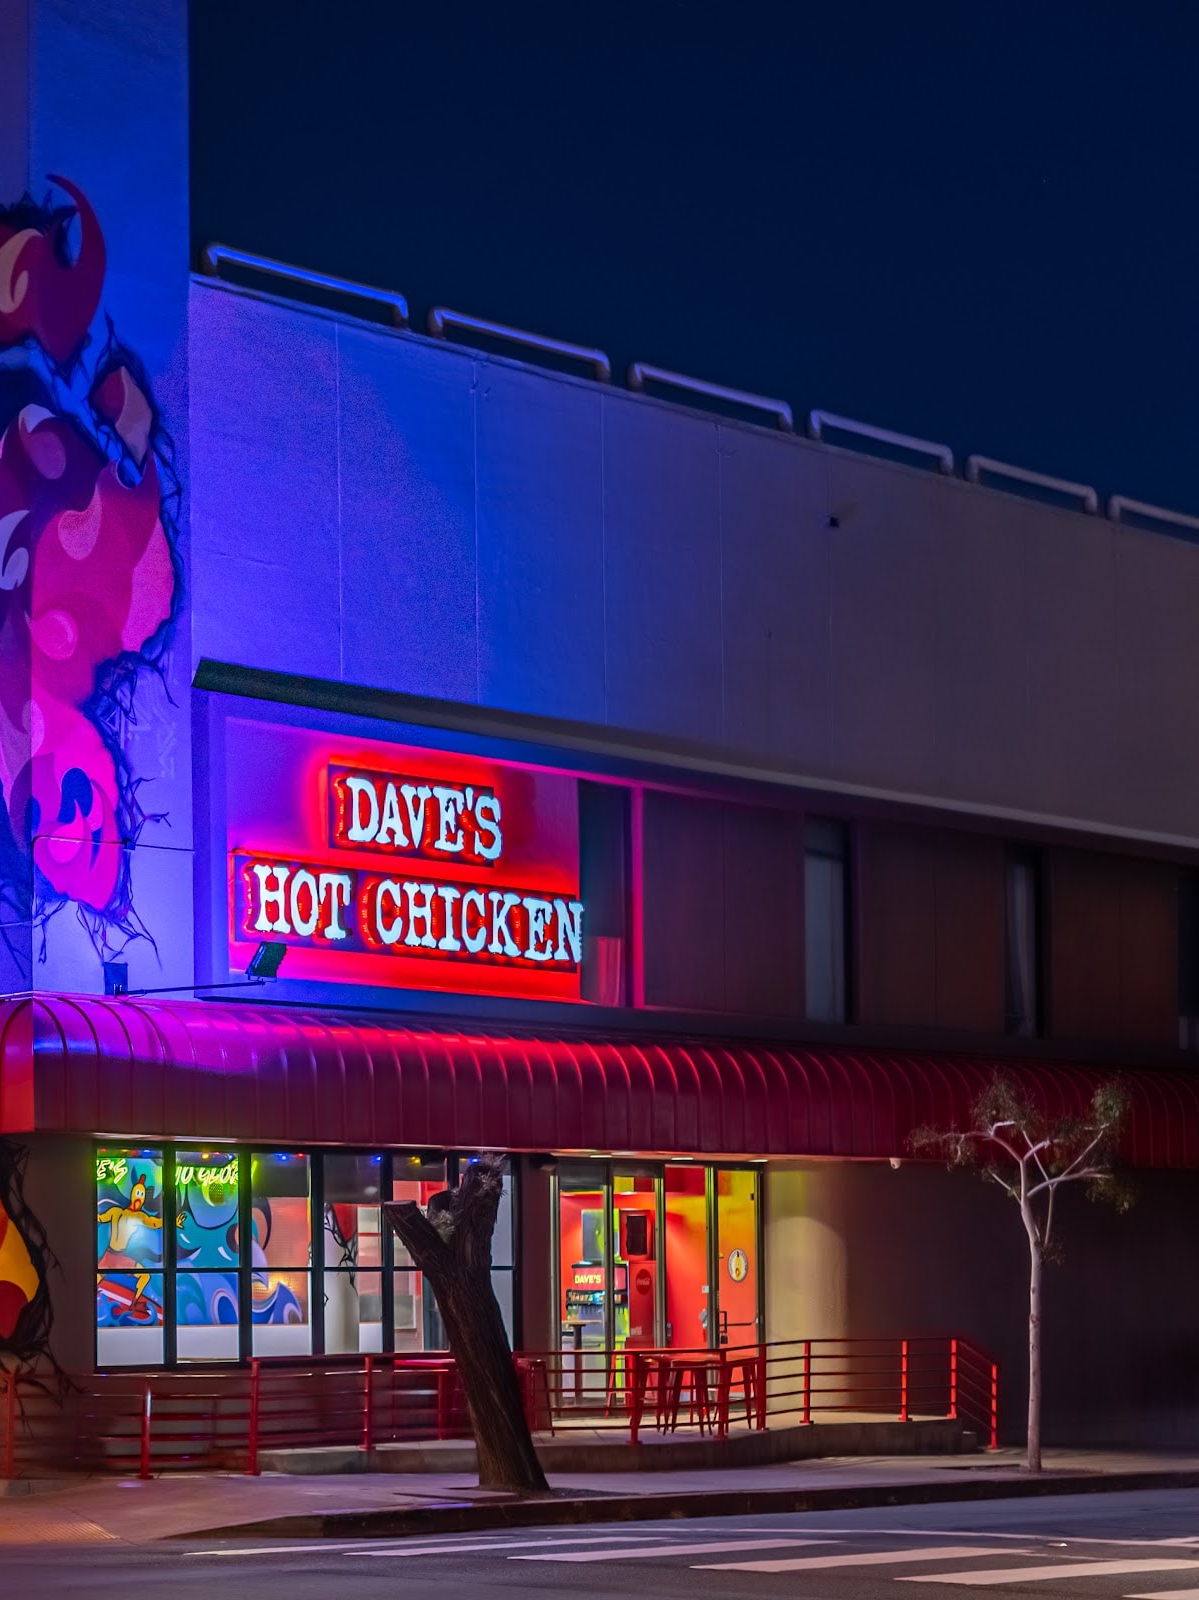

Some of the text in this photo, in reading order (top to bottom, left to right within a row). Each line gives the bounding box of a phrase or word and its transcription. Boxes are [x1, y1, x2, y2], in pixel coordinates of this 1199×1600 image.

[345, 776, 502, 860] DAVE'S
[253, 864, 585, 964] HOT CHICKEN
[574, 1274, 602, 1284] DAVE'S
